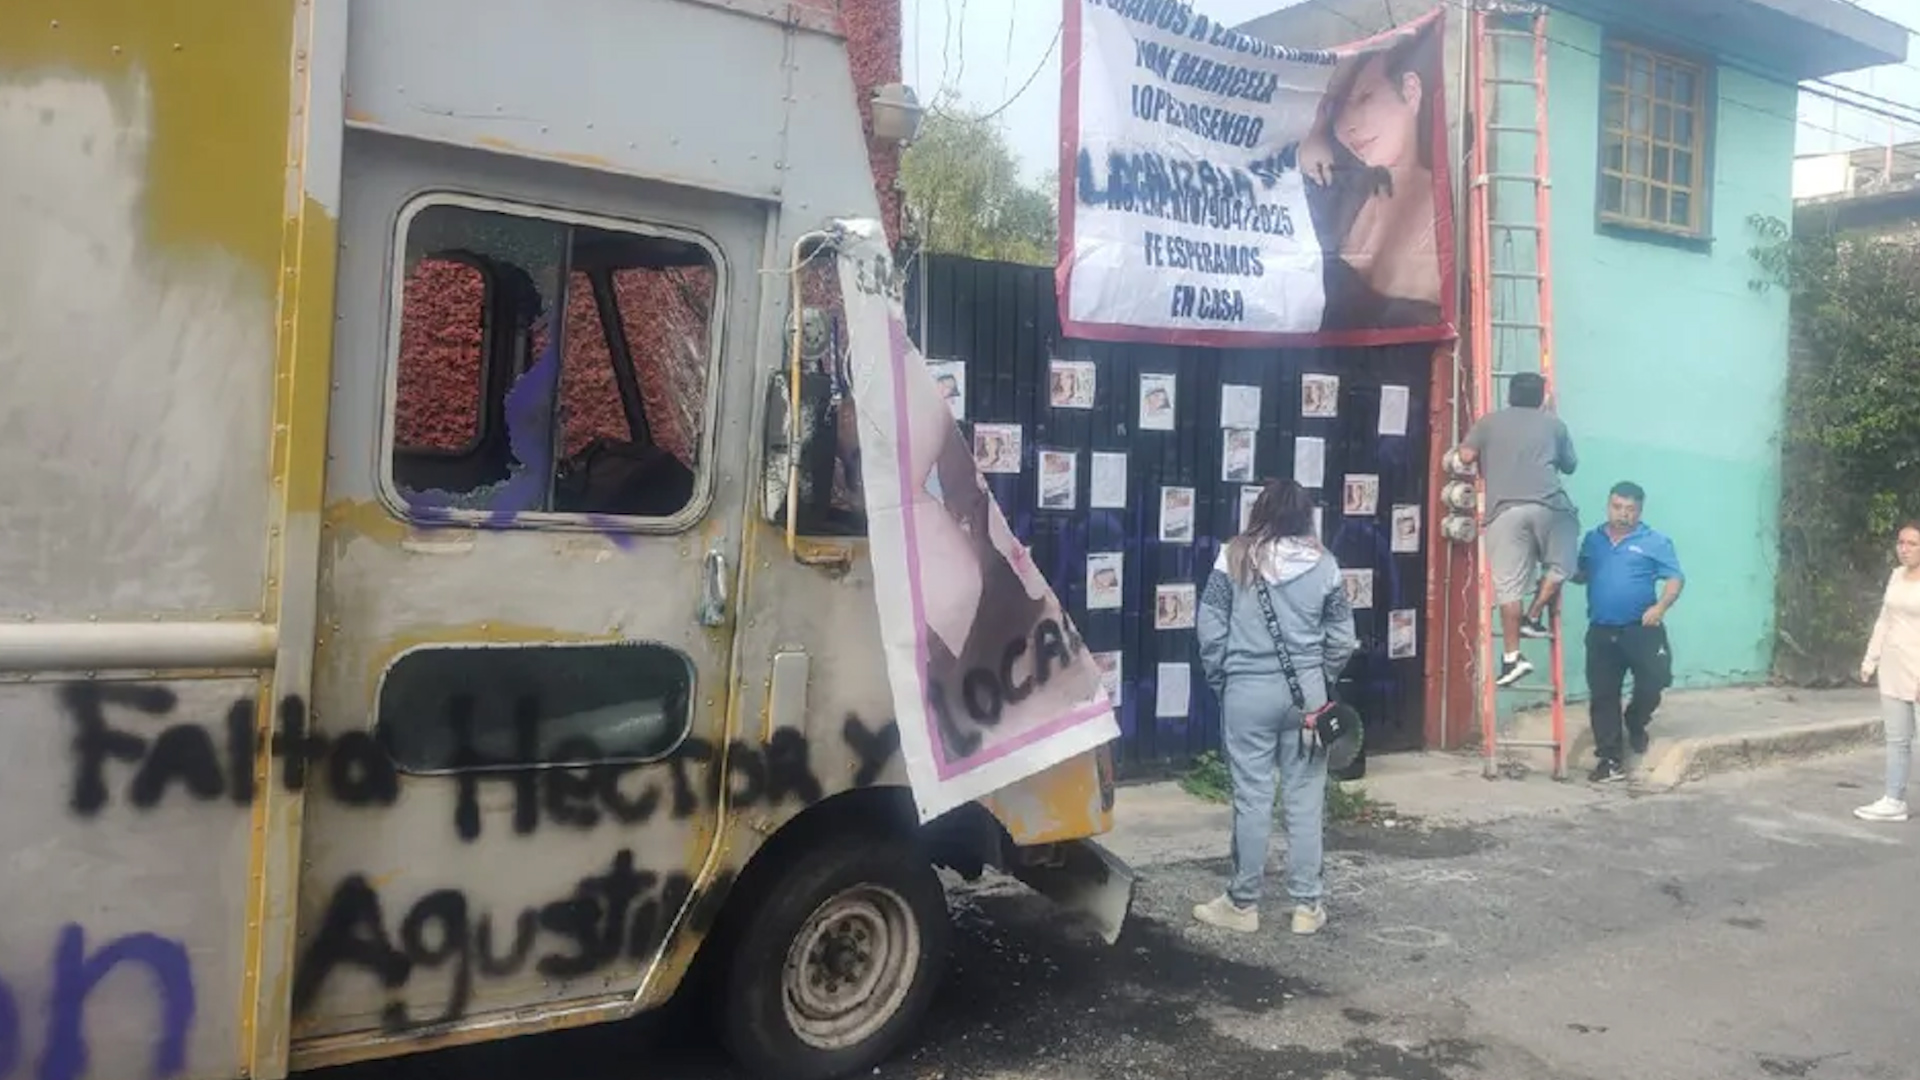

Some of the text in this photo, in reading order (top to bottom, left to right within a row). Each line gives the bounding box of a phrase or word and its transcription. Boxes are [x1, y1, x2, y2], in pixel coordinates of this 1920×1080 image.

[1171, 52, 1279, 103] MARICELA
[1166, 235, 1264, 278] ESPERAMOS
[1171, 284, 1244, 322] EN CASA
